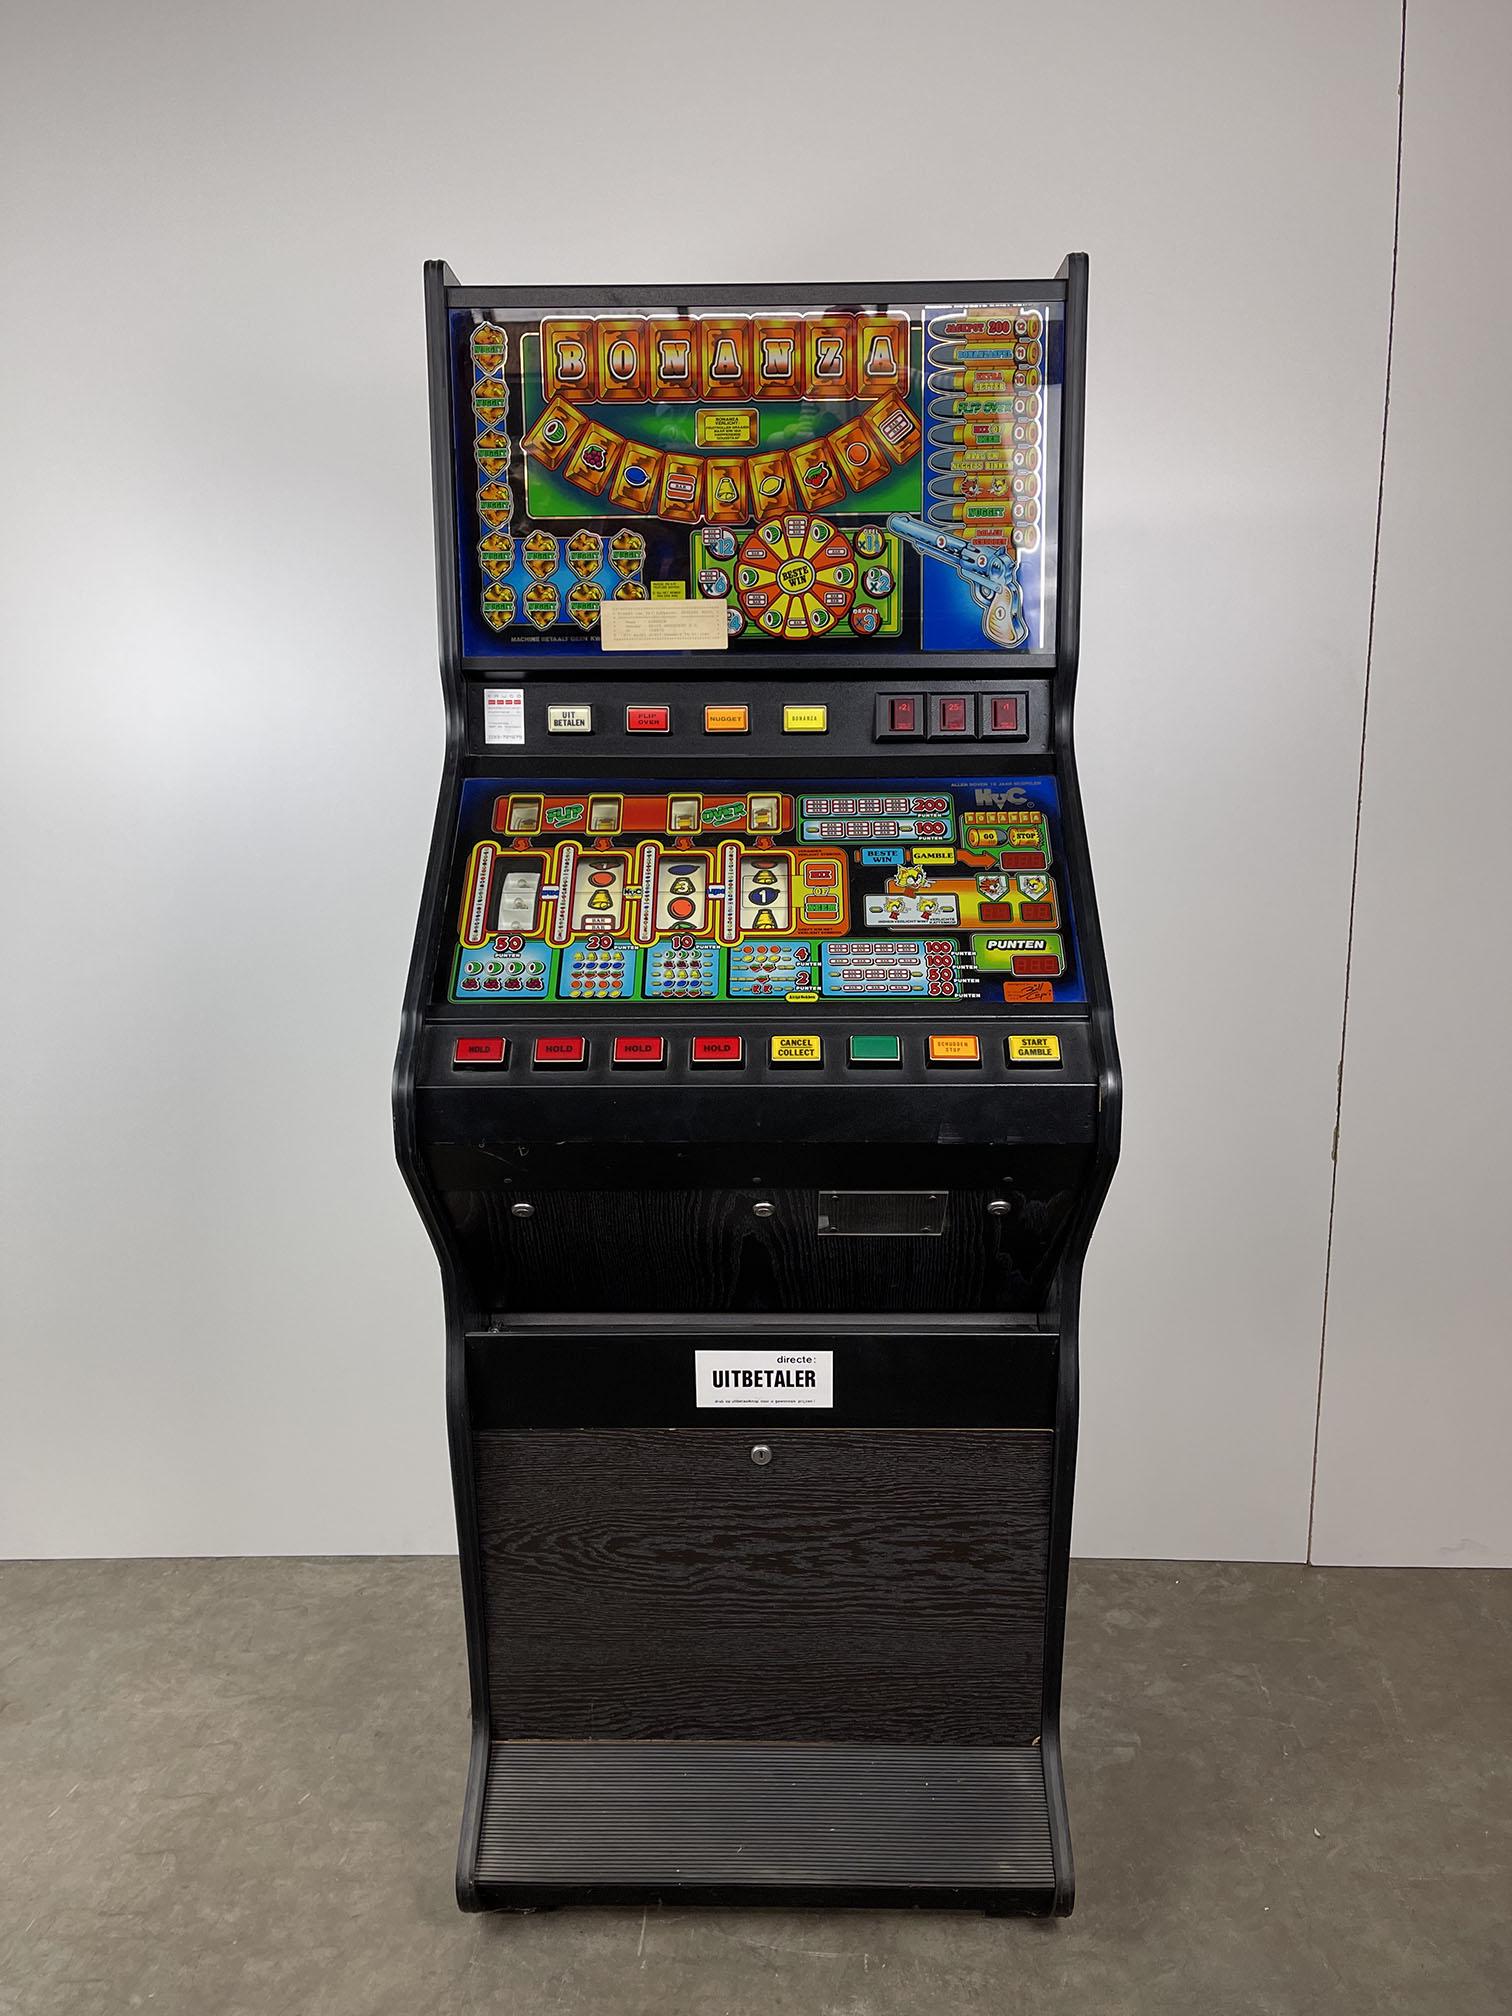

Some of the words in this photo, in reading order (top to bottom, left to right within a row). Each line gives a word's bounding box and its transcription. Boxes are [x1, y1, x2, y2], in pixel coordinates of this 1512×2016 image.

[945, 323, 985, 333] JACKPOT
[988, 320, 1011, 334] 200
[557, 336, 897, 380] BONANZA
[967, 507, 1005, 518] NUGGET
[781, 565, 809, 581] BESTE
[788, 575, 807, 587] WIN
[562, 711, 576, 719] UIT
[553, 719, 585, 727] BETALEN
[912, 797, 948, 813] 200
[546, 804, 584, 823] FLIP
[701, 802, 747, 823] OVER
[914, 821, 946, 836] 100
[983, 832, 994, 840] GO
[1016, 832, 1036, 840] STOP
[913, 851, 954, 859] GAMBLE
[758, 890, 767, 903] 1
[494, 936, 522, 951] 50
[586, 936, 613, 950] 20
[672, 936, 694, 950] 10
[925, 942, 953, 954] 100
[987, 940, 1045, 949] PUNTEN
[794, 948, 809, 961] 4
[926, 955, 953, 967] 100
[796, 971, 810, 986] 2
[928, 968, 953, 982] 50
[928, 982, 954, 996] 50
[703, 1044, 731, 1052] HOLD
[780, 1039, 813, 1047] CANCEL
[1021, 1038, 1047, 1047] START
[468, 1045, 491, 1054] HOLD
[546, 1045, 573, 1053] HOLD
[625, 1045, 652, 1053] HOLD
[777, 1048, 815, 1057] COLLECT
[1018, 1048, 1052, 1056] GAMBLE
[712, 1370, 816, 1388] UITBETALER
